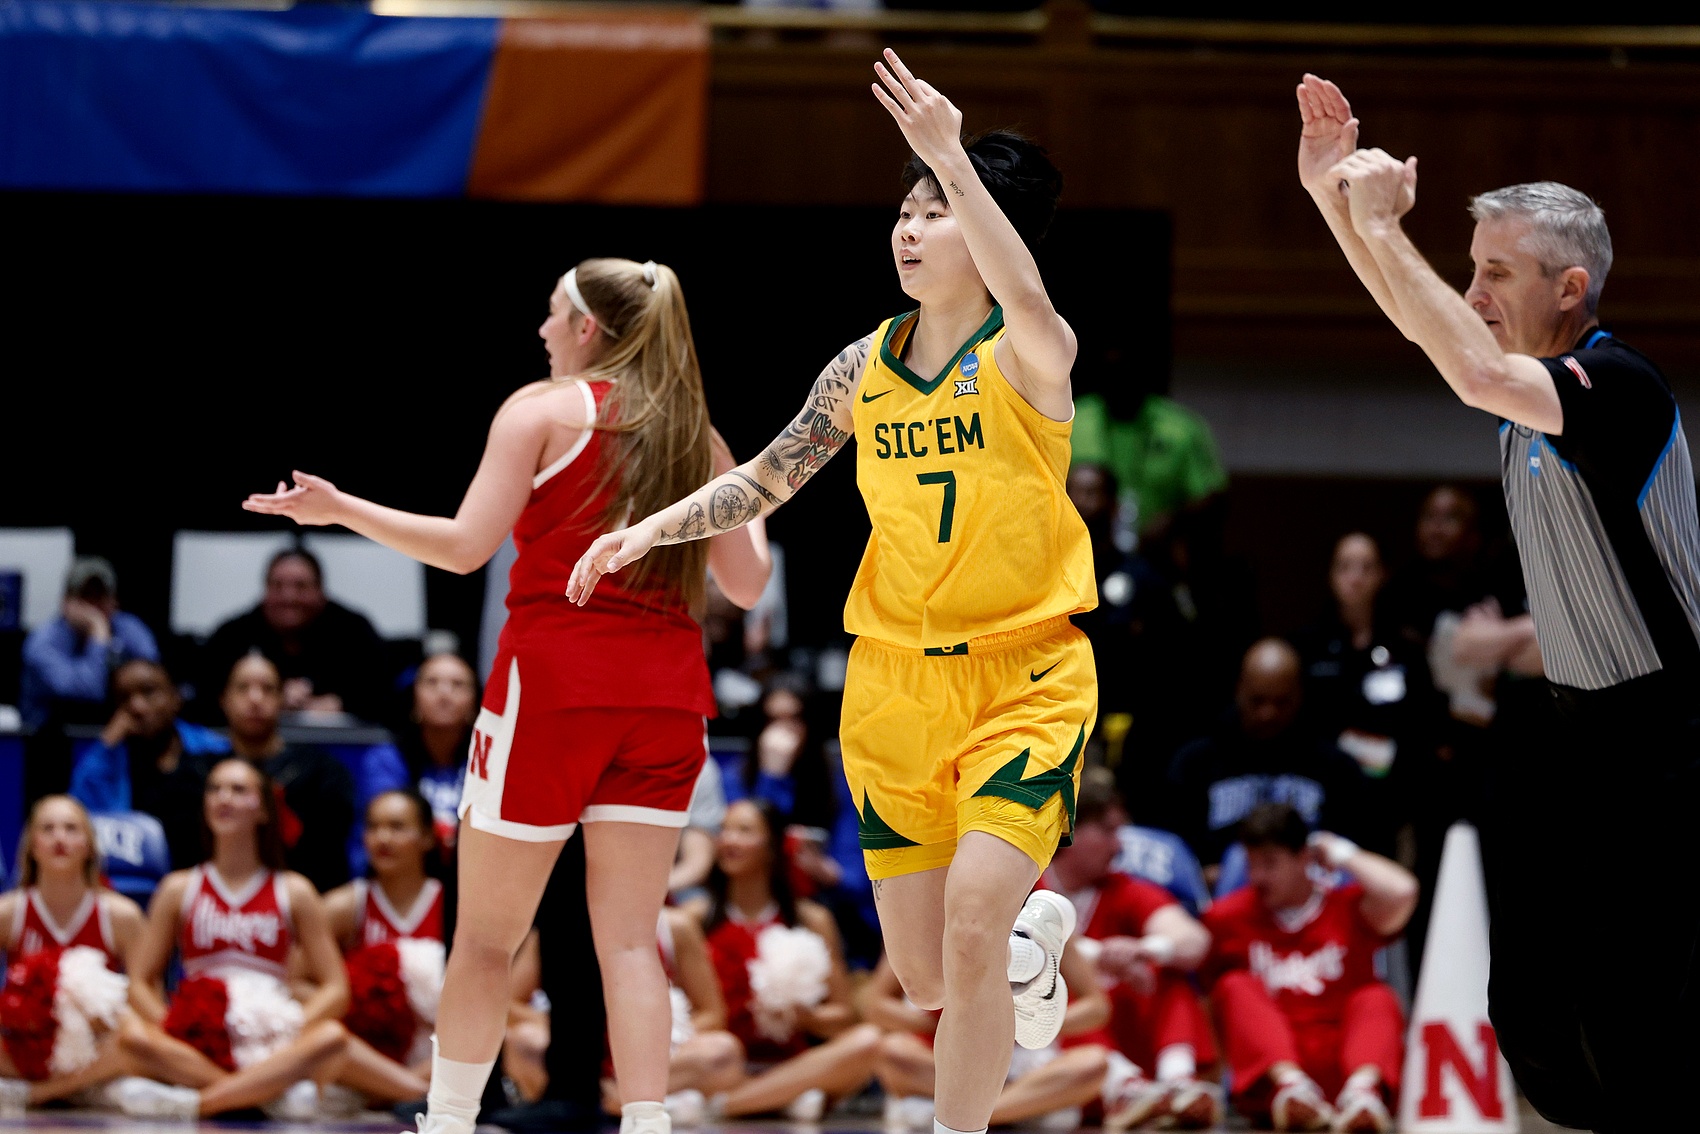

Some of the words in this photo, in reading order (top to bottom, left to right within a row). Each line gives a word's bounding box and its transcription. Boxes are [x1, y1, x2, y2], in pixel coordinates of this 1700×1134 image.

[954, 377, 979, 398] XII
[875, 412, 985, 459] SIC'EM
[916, 470, 957, 543] 7
[470, 728, 493, 780] N
[1418, 1022, 1504, 1121] N
